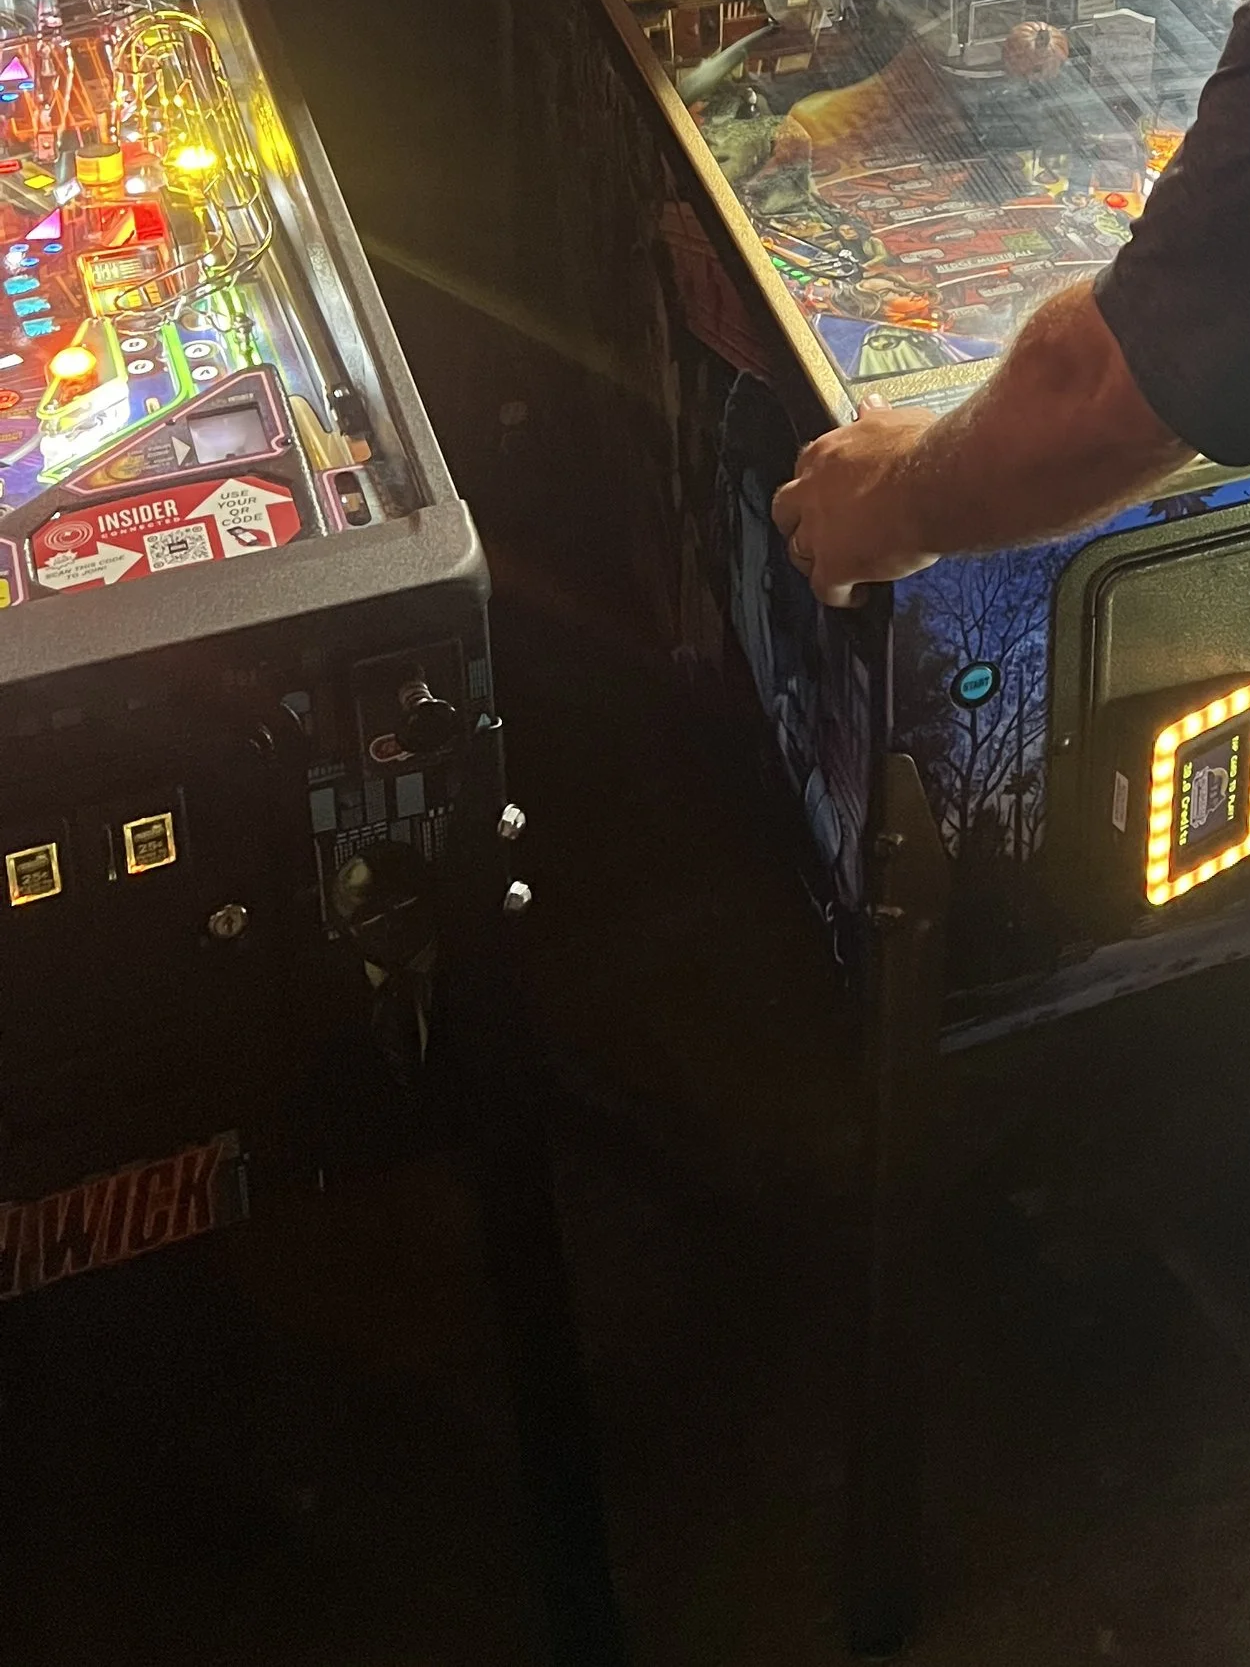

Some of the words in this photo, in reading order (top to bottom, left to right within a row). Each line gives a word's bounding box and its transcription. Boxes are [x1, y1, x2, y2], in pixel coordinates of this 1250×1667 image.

[220, 489, 249, 501] USE
[217, 497, 257, 510] YOUR
[97, 499, 178, 534] INSIDER
[221, 513, 264, 527] CODE
[100, 517, 188, 539] CONNECTED
[963, 676, 990, 692] START
[1178, 795, 1191, 846] Credits
